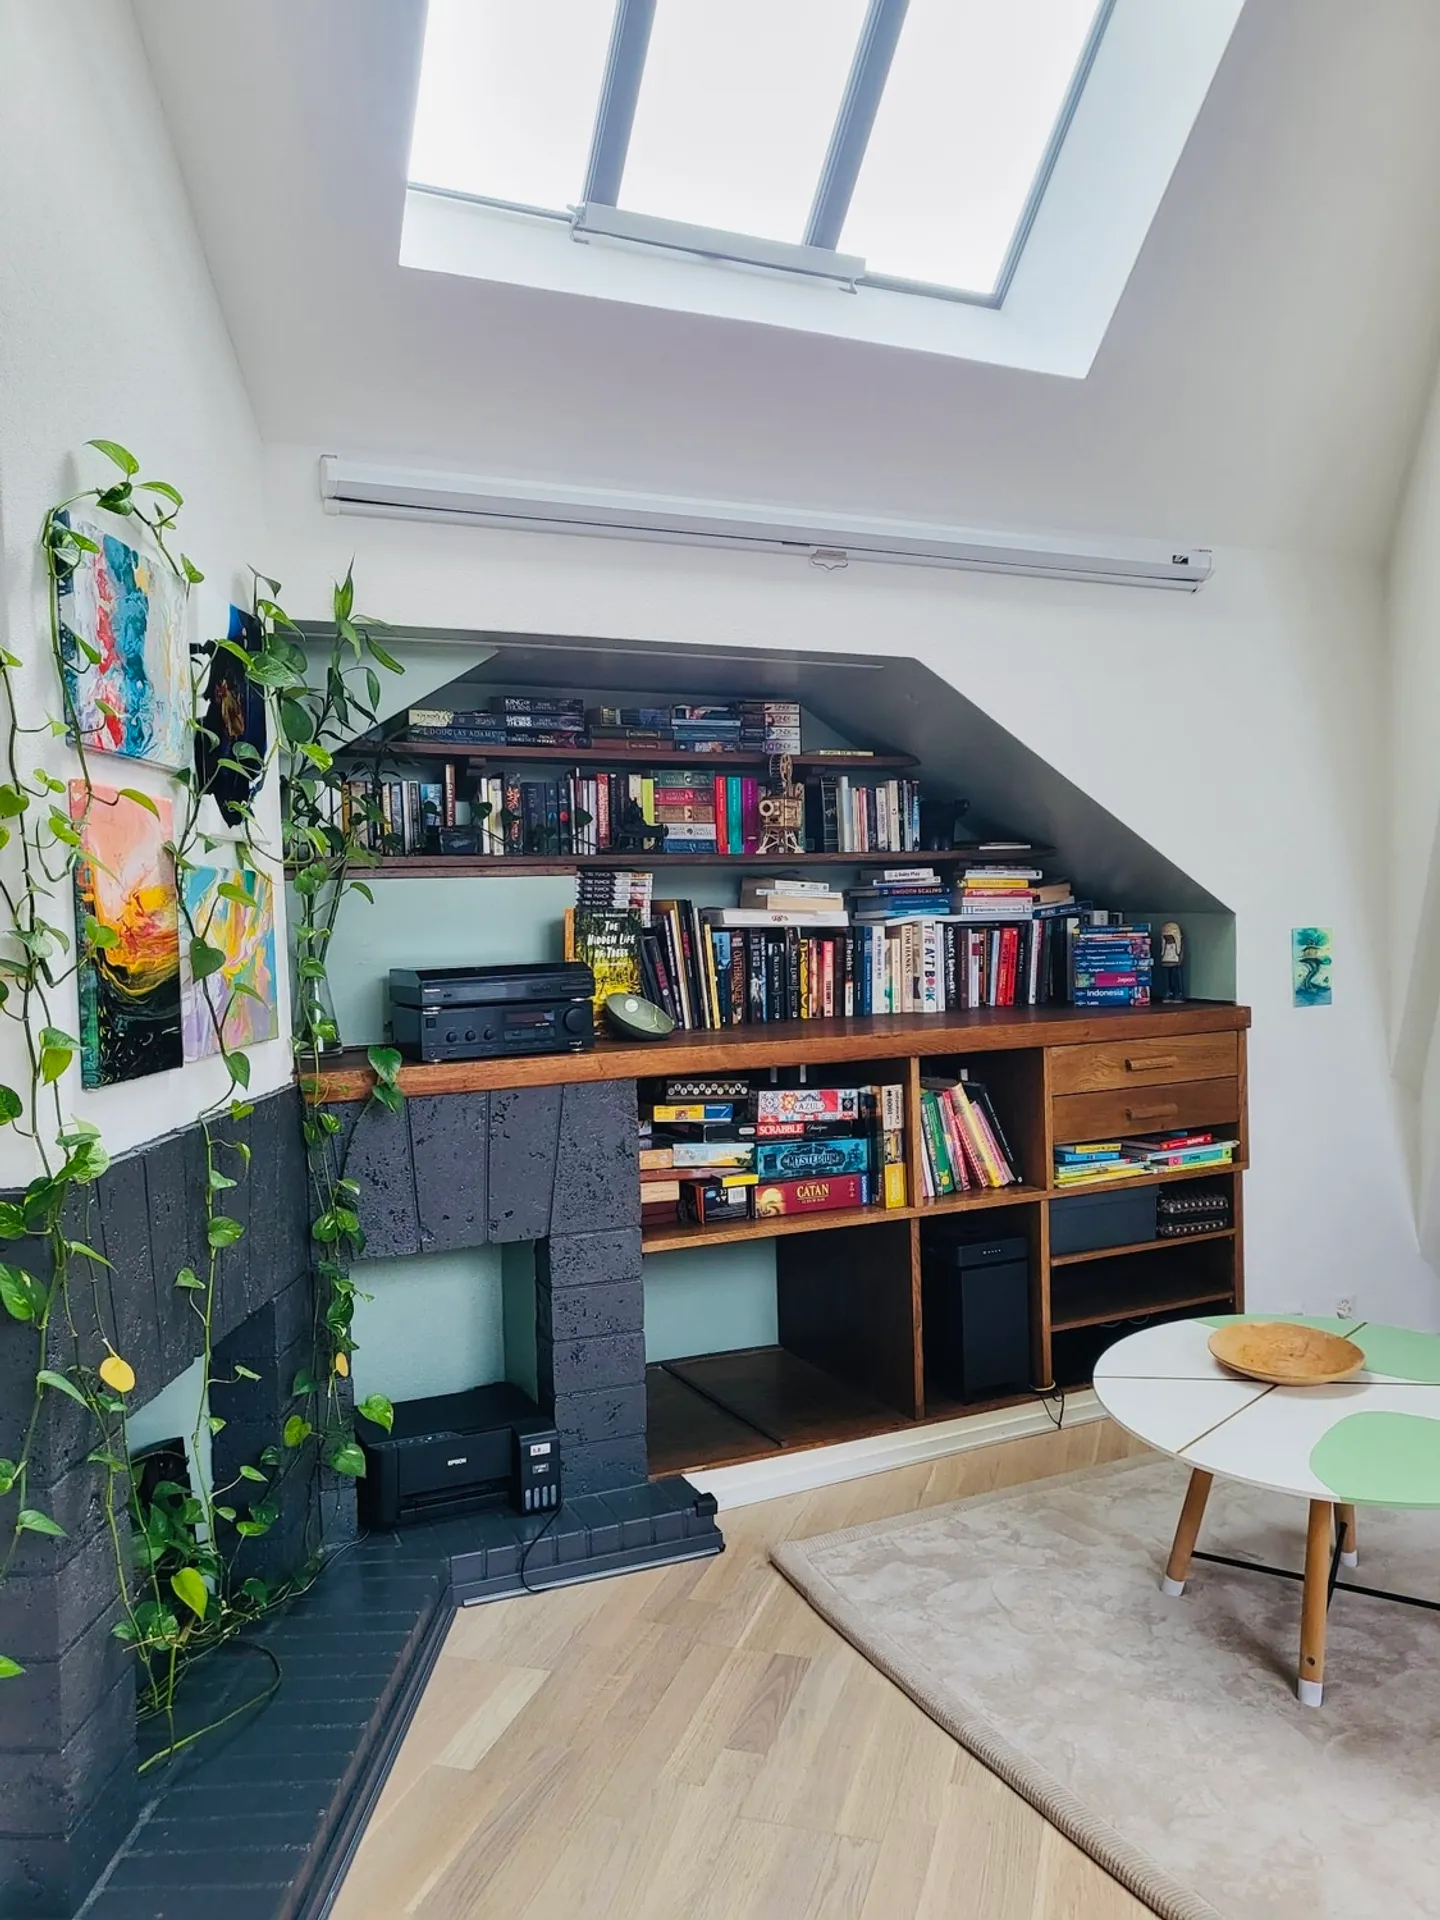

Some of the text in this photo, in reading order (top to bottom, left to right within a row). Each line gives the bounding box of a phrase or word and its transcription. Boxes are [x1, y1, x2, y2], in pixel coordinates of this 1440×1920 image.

[604, 921, 620, 932] THE
[904, 927, 912, 945] TOM
[732, 950, 744, 1005] OATHBRINGER
[1116, 976, 1136, 984] Japan
[924, 970, 935, 1002] BOOK
[1086, 989, 1124, 997] Indonesia
[799, 1101, 821, 1110] AZUL
[758, 1123, 803, 1135] SCRABBLE
[787, 1151, 840, 1167] MYSTERIUM
[796, 1183, 830, 1198] CATAN
[447, 1457, 467, 1466] EPSON
